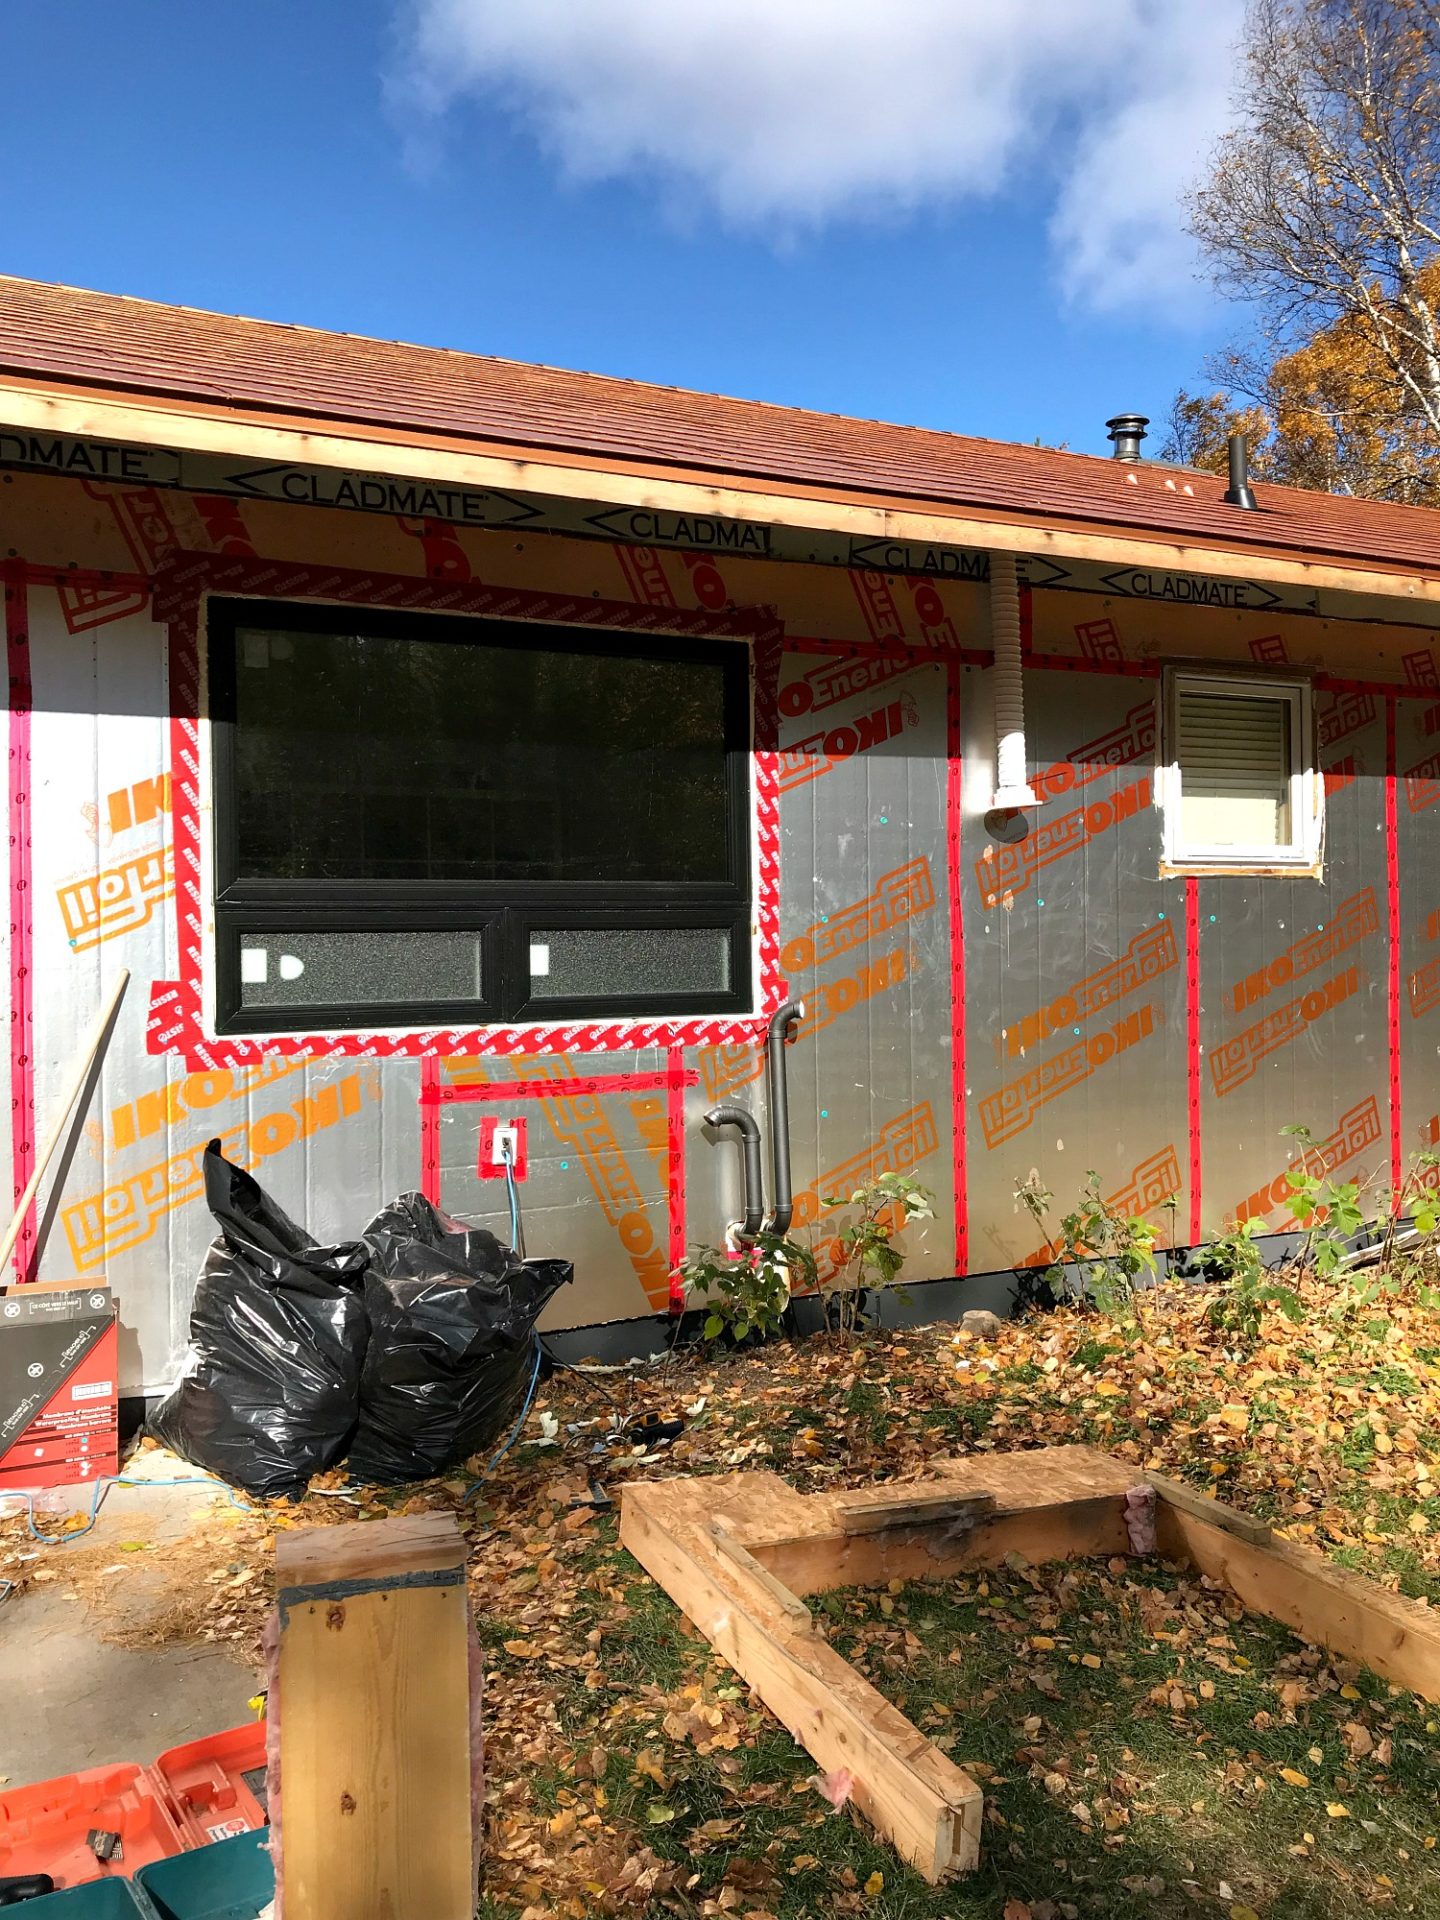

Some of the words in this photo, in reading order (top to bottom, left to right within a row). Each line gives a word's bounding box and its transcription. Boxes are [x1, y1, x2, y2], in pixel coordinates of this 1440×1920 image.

[281, 473, 487, 520] CLADMATE
[1131, 574, 1248, 607] CLADMATE
[823, 702, 903, 762] IKO
[107, 771, 173, 834] IK
[1085, 777, 1151, 834] IKO
[807, 856, 936, 964] Enerfoil
[825, 947, 906, 1013] IKO
[1007, 996, 1077, 1059] IKO
[1070, 919, 1178, 1022] Enerfoil
[1233, 956, 1294, 1013] IKO
[1300, 966, 1358, 1022] IKO
[1088, 1002, 1154, 1066] IKO
[111, 1069, 234, 1150] IKO
[250, 1072, 361, 1156] IKO
[979, 1041, 1093, 1149] Enerfoil
